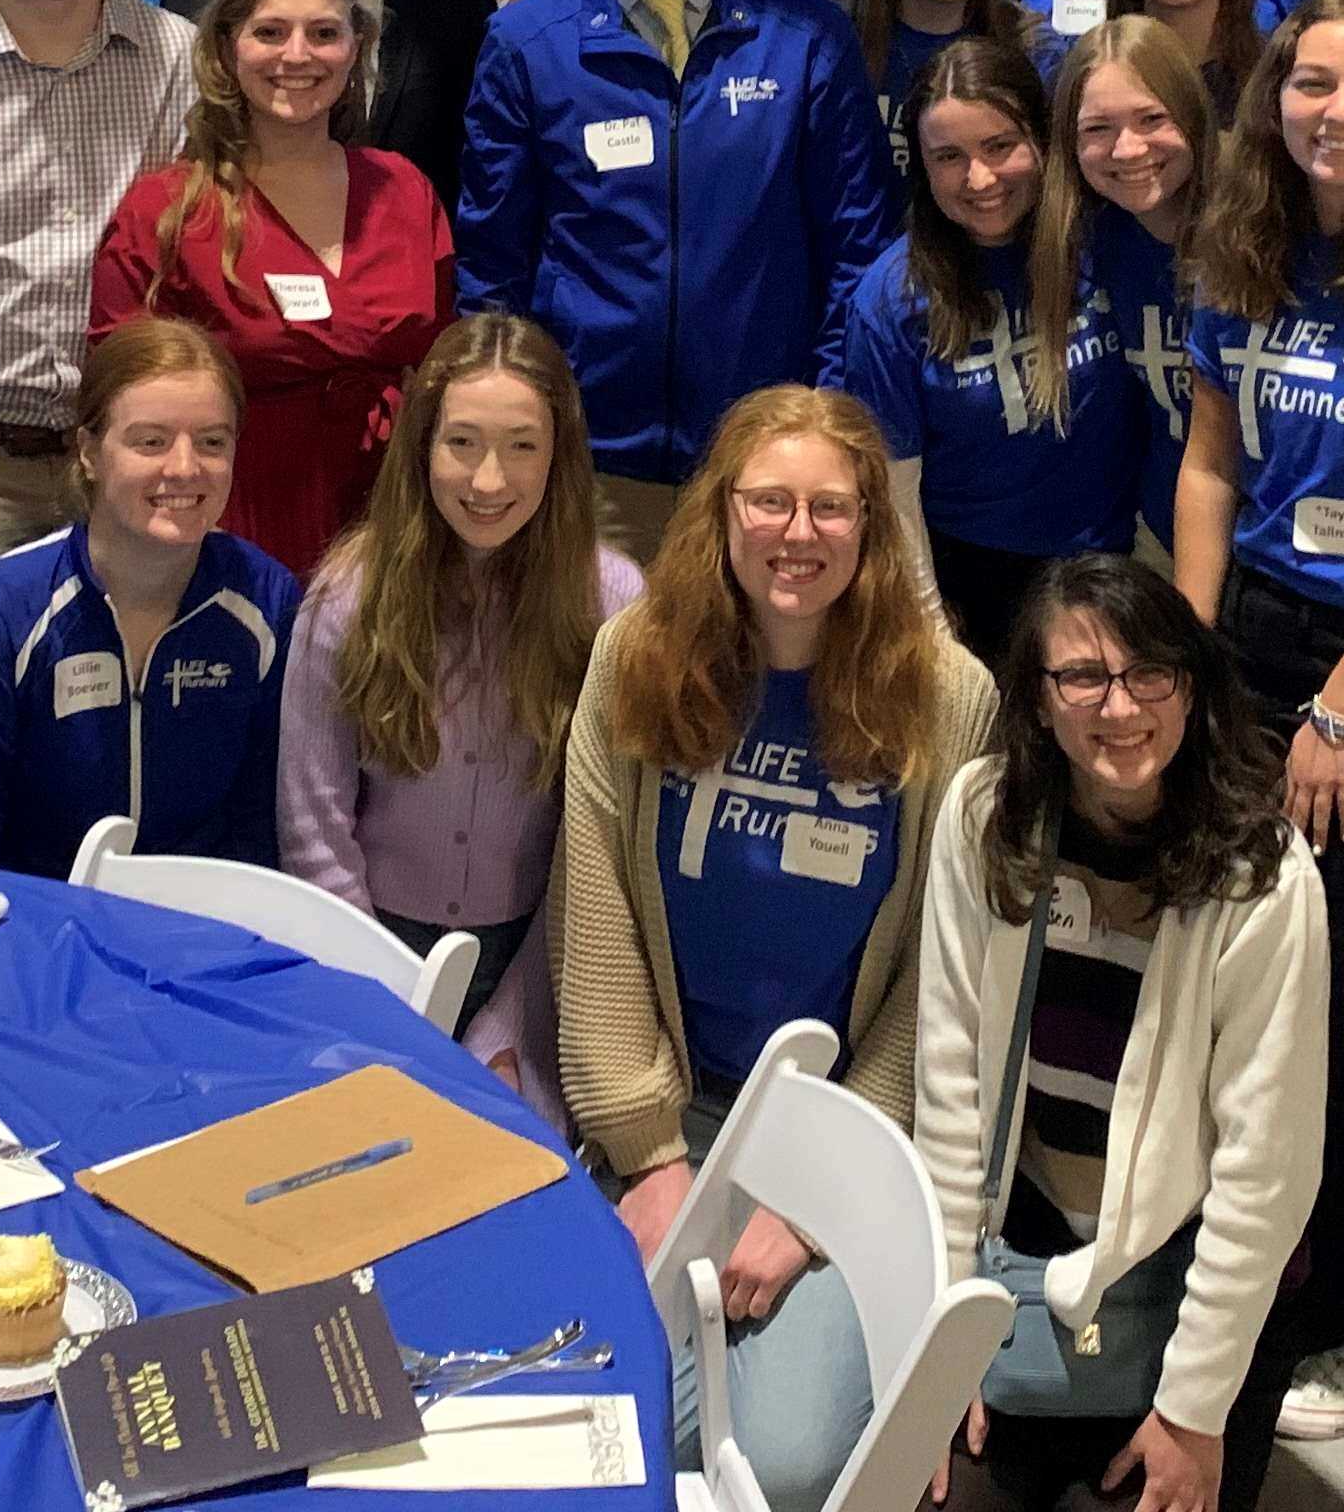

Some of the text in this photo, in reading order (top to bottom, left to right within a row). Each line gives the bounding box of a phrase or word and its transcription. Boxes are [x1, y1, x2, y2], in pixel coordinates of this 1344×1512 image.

[607, 135, 641, 148] Castle
[1268, 320, 1335, 358] LIFE
[730, 737, 808, 783] LIFE
[808, 837, 850, 856] Youell
[814, 817, 849, 834] Anna
[224, 1325, 249, 1380] DELGADO
[127, 1367, 160, 1446] ANNUAL
[143, 1361, 182, 1452] BANQUET
[239, 1380, 261, 1428] GEORGE
